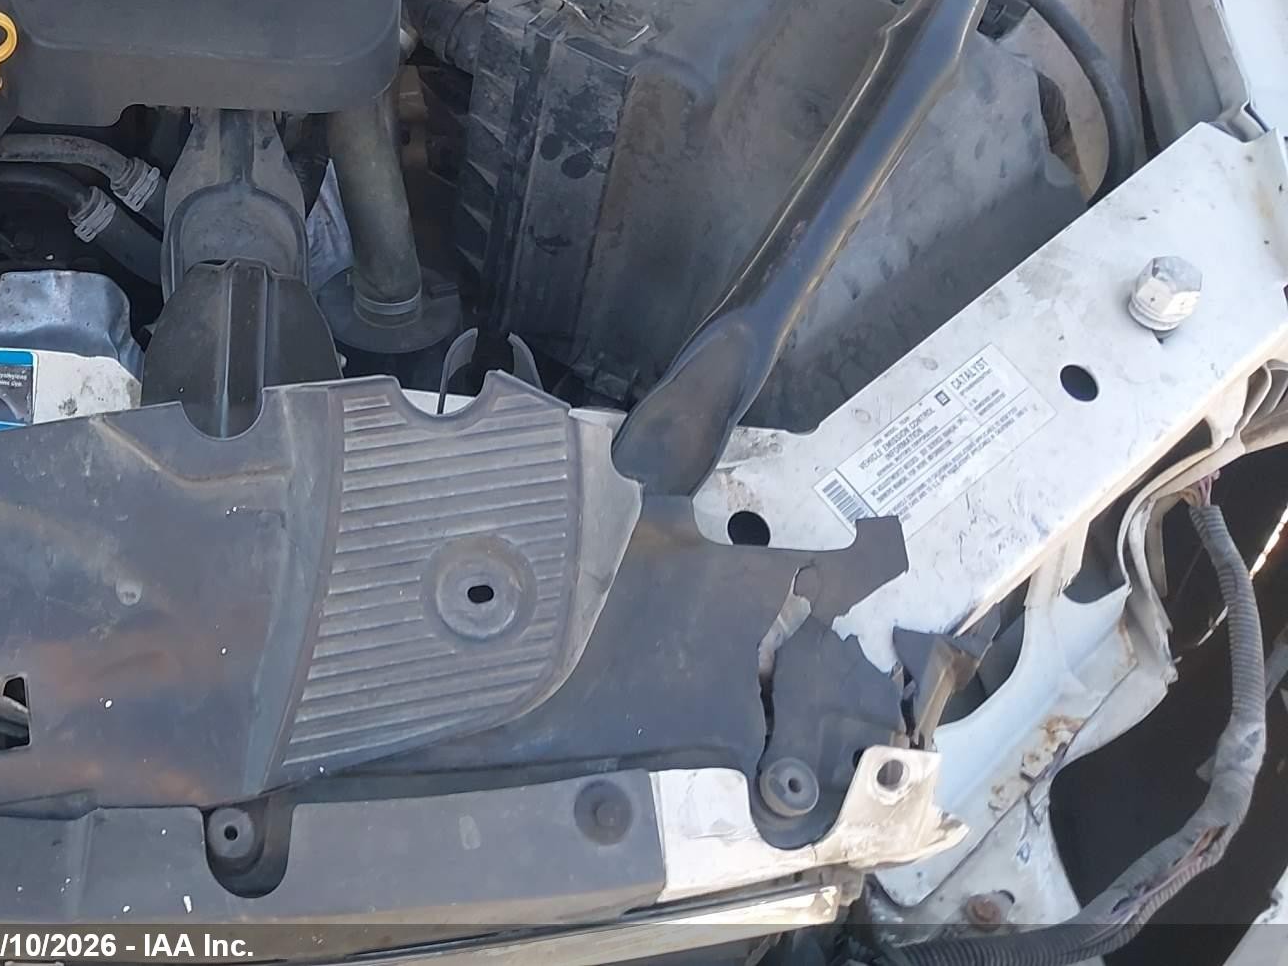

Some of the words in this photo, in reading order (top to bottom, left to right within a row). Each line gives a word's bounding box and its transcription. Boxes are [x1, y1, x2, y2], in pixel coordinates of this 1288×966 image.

[950, 357, 989, 390] CATALYST
[859, 448, 883, 470] VEHICLE
[882, 427, 910, 451] EMISSION
